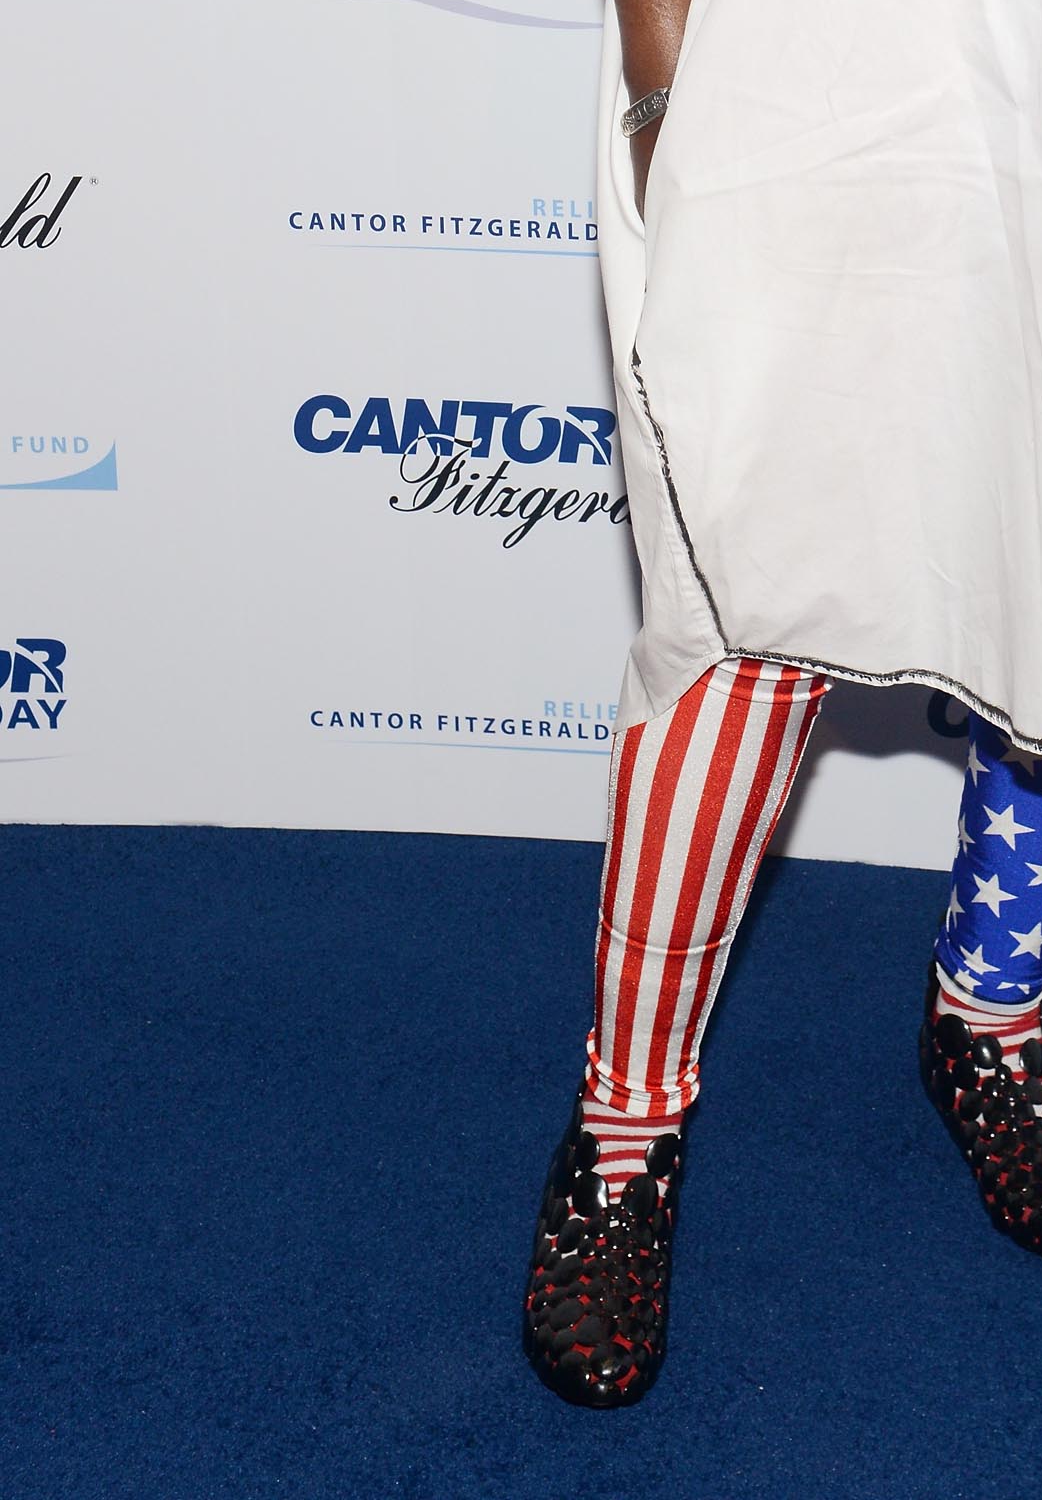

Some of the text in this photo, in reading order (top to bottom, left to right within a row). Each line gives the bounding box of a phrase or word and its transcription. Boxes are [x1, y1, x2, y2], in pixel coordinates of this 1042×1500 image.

[289, 212, 598, 241] CANTOR FITZGERALD
[294, 394, 616, 465] CANTOR
[12, 436, 89, 454] FUND
[310, 711, 609, 741] CANTOR FITZGERALD
